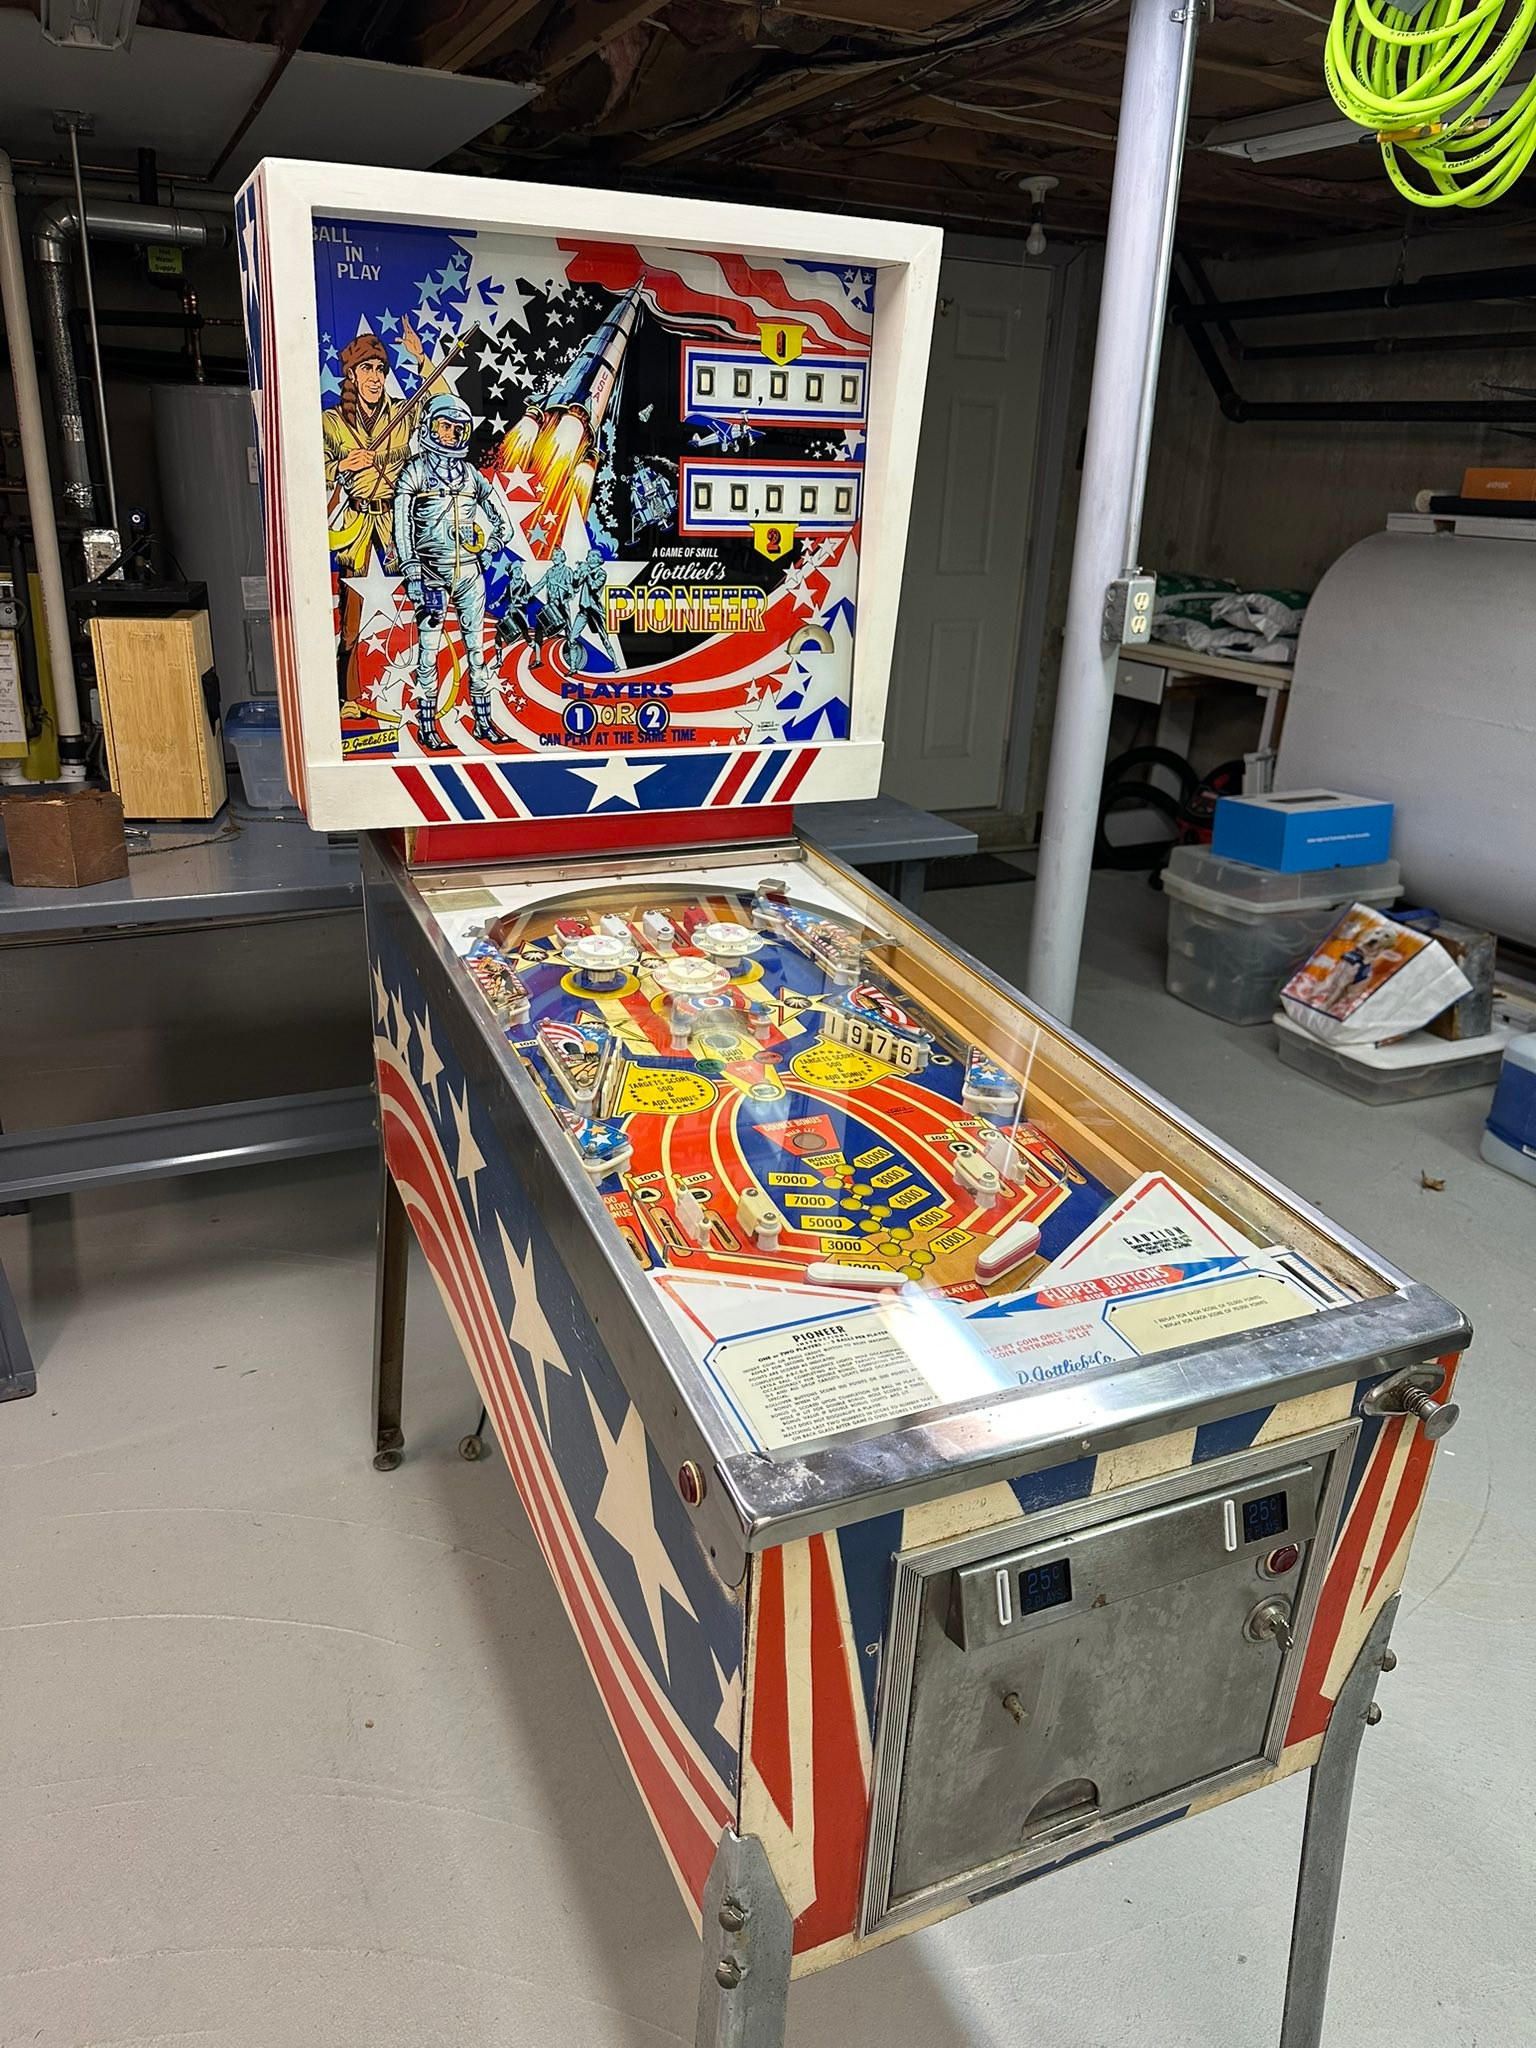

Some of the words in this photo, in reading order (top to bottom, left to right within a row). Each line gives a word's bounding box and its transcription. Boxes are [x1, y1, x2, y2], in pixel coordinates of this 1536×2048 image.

[312, 225, 353, 244] BALL
[345, 246, 363, 262] IN
[337, 262, 381, 281] PLAY
[593, 372, 608, 403] USA
[766, 527, 782, 554] 2
[652, 547, 658, 558] A
[659, 547, 683, 558] GAME
[684, 547, 695, 558] OF
[695, 548, 719, 558] SKILL
[647, 561, 726, 587] Gottlieb's
[605, 585, 768, 634] PIONEER
[561, 682, 674, 699] PLAYERS
[574, 707, 584, 730] 1
[601, 702, 637, 726] OR
[646, 705, 660, 728] 2
[539, 733, 561, 746] CAN
[564, 733, 593, 746] PLAY
[595, 732, 609, 745] AT
[613, 731, 635, 744] THE
[638, 729, 667, 743] SAME
[671, 728, 696, 742] TIME
[718, 1048, 743, 1057] 1000
[799, 1056, 832, 1065] TARGETS
[832, 1052, 856, 1060] SCORE
[628, 1079, 664, 1090] TARGETS
[665, 1075, 692, 1084] SCORE
[824, 1073, 840, 1081] ADD
[841, 1070, 868, 1078] BONUS
[652, 1098, 669, 1106] ADD
[670, 1095, 699, 1104] BONUS
[763, 1120, 795, 1132] DOUBLE
[795, 1116, 822, 1126] BONUS
[807, 1153, 840, 1163] BONUS
[813, 1158, 843, 1167] VALUE
[857, 1148, 890, 1168] 10,000
[639, 1173, 658, 1182] 100
[687, 1174, 707, 1183] 100
[775, 1174, 808, 1185] 9000
[876, 1169, 905, 1185] 8000
[640, 1190, 657, 1200] A
[793, 1195, 826, 1207] 7000
[894, 1189, 923, 1206] 6000
[809, 1218, 842, 1229] 5000
[915, 1211, 944, 1228] 4000
[935, 1232, 966, 1250] 2000
[1122, 1226, 1186, 1246] CAUTION
[828, 1240, 861, 1251] 3000
[938, 1283, 978, 1297] PLAYER
[1043, 1280, 1101, 1301] FLIPPER
[1102, 1266, 1169, 1289] BUTTONS
[1065, 1297, 1080, 1305] ON
[1085, 1292, 1107, 1301] SIDE
[1130, 1280, 1169, 1292] CABINET
[792, 1325, 846, 1343] PIONEER
[796, 1333, 849, 1347] INSTRUCTIONS
[1016, 1336, 1039, 1347] COIN
[1040, 1330, 1063, 1341] ONLY
[1065, 1323, 1094, 1335] WHEN
[758, 1355, 771, 1363] ONE
[780, 1348, 795, 1357] TWO
[796, 1342, 822, 1353] PLAYERS
[836, 1335, 854, 1343] BALLS
[866, 1330, 888, 1339] PLAYER
[992, 1348, 1017, 1360] COIN
[1018, 1337, 1066, 1354] ENTRANCE
[1077, 1330, 1091, 1339] LIT
